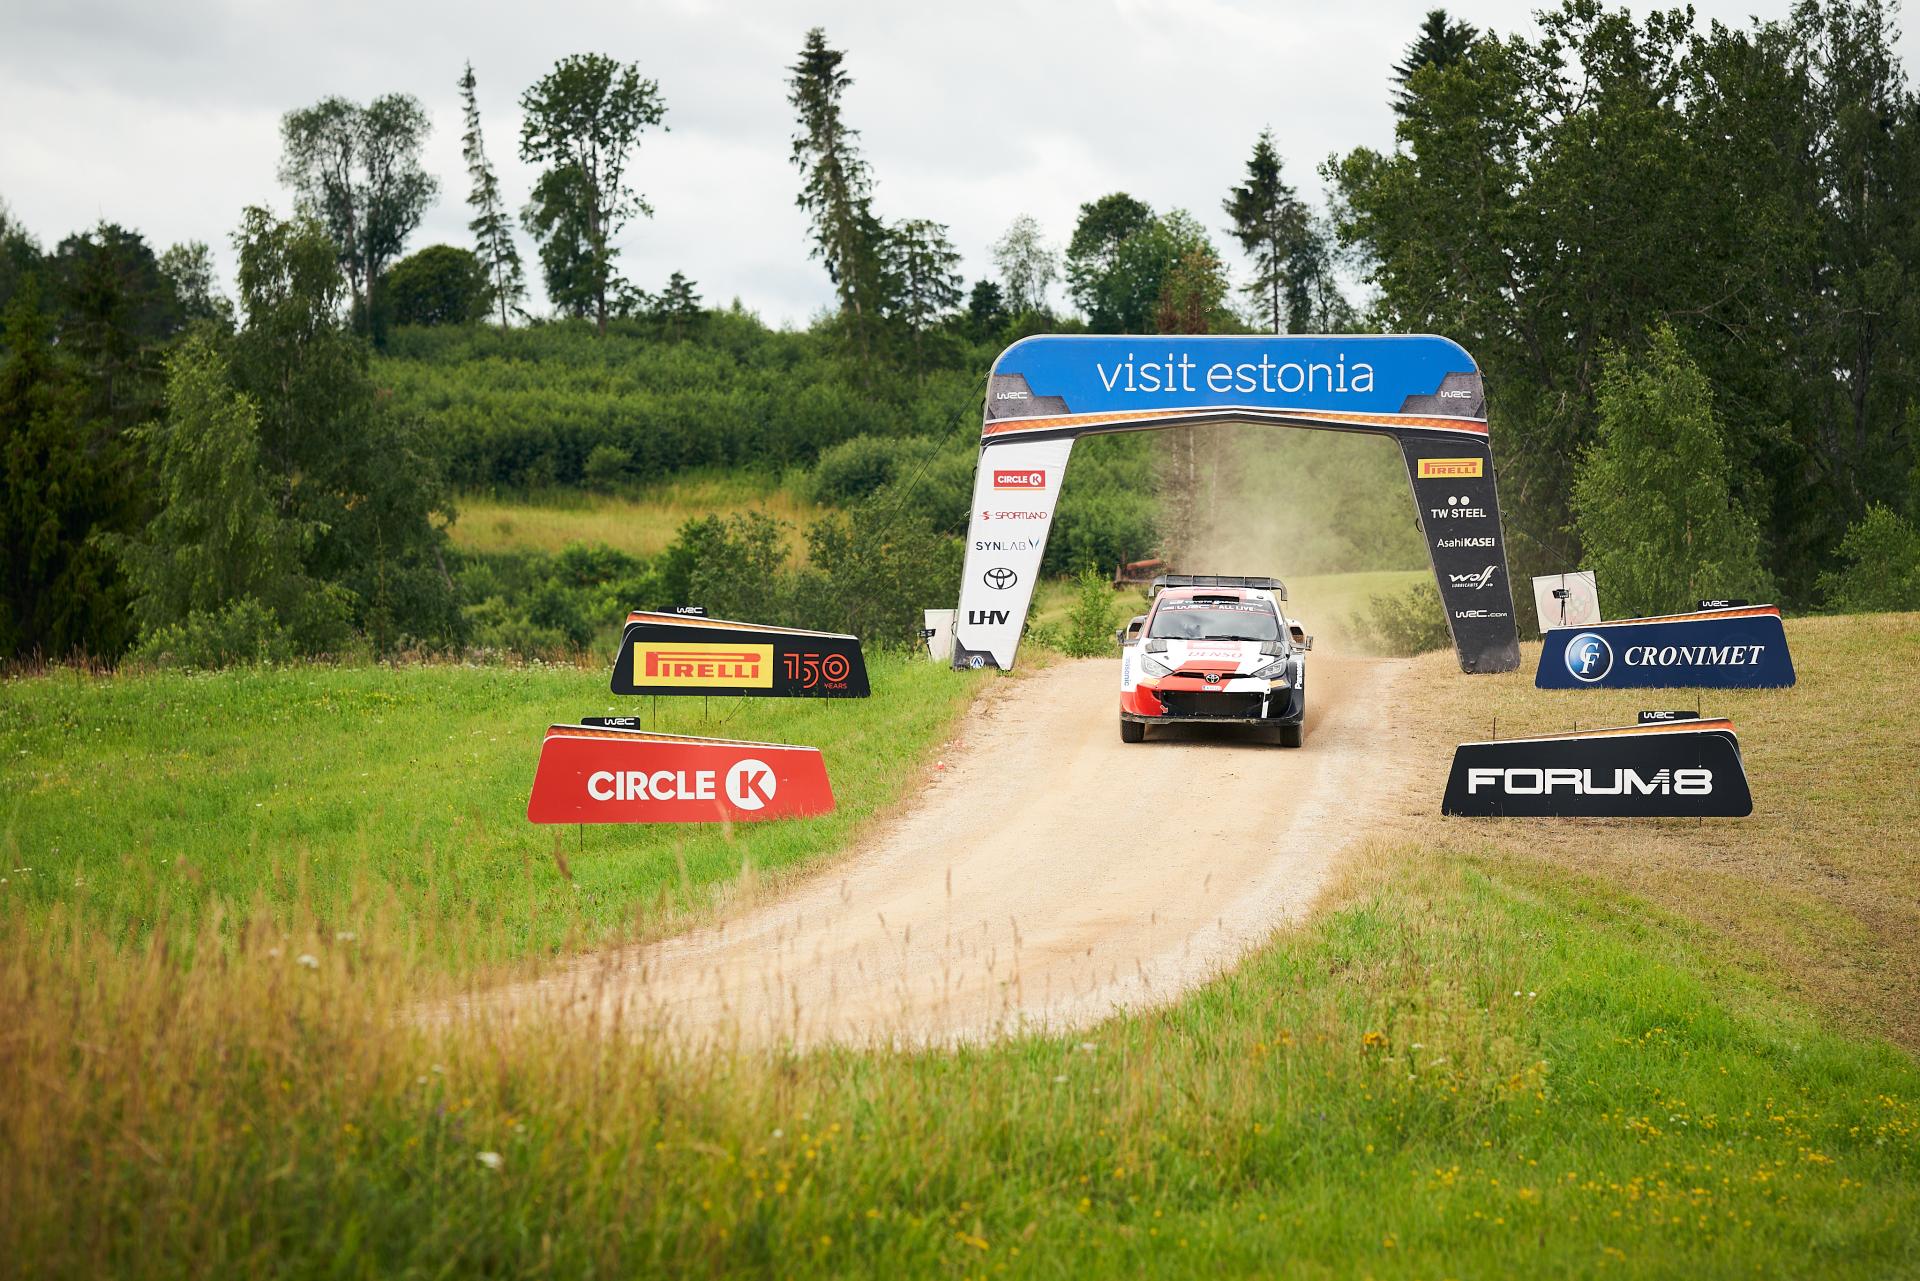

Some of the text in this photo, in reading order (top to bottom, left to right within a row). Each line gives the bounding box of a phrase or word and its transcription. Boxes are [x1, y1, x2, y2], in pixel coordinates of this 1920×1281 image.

[1096, 352, 1374, 393] visit estonia
[997, 391, 1028, 400] WRC
[1440, 390, 1471, 399] WRC
[1424, 461, 1477, 475] PIRELLI
[997, 475, 1028, 484] CIRCLE
[995, 511, 1047, 520] SPORTLAND
[1431, 508, 1487, 519] TW STEEL
[975, 541, 1026, 551] SYNLAB
[968, 610, 1010, 625] LHV
[1455, 609, 1508, 619] WRC.com
[1187, 651, 1243, 659] DENSO
[1624, 645, 1765, 666] CRONIMET
[646, 651, 761, 679] PIRELLI
[783, 653, 850, 689] 150
[1643, 711, 1675, 719] WRC
[604, 718, 635, 726] WRC
[587, 770, 716, 801] CIRCLE
[1467, 768, 1713, 795] FORUM8
